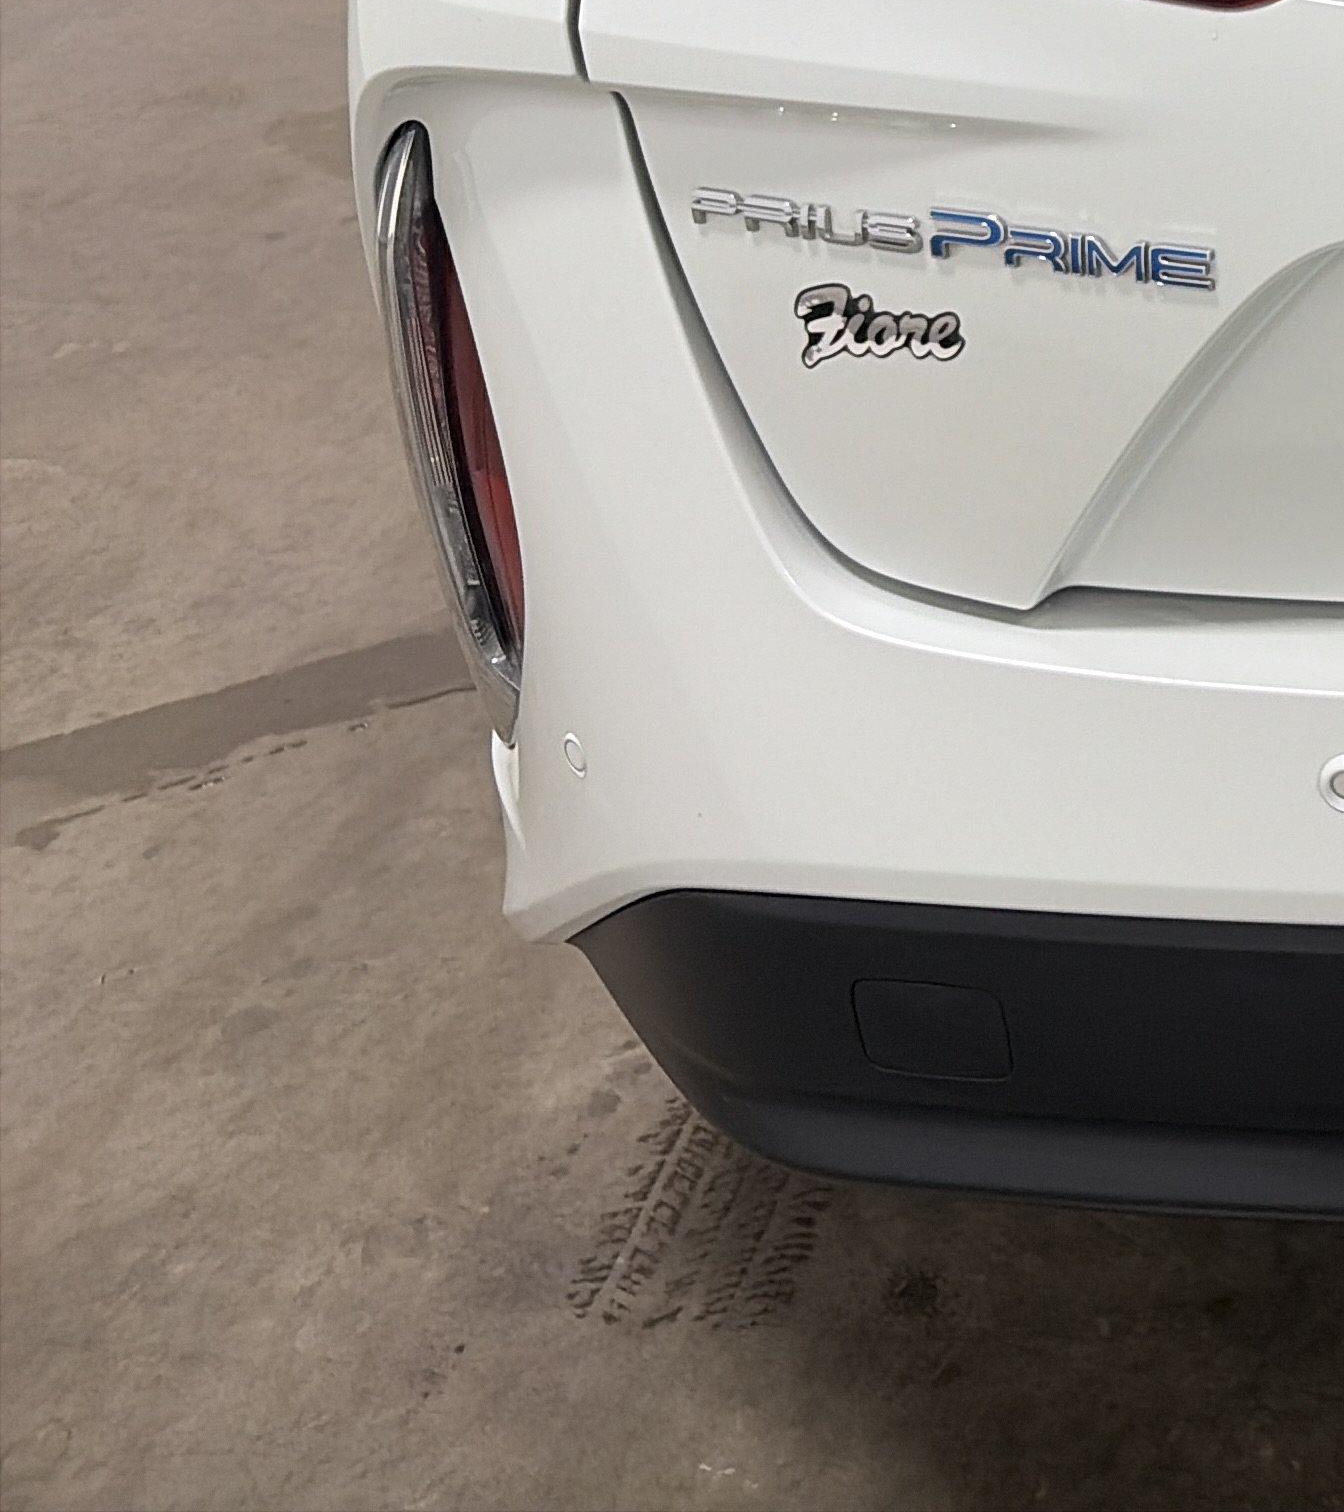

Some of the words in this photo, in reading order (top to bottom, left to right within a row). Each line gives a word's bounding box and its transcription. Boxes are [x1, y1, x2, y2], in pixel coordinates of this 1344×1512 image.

[691, 186, 924, 254] PRIUS
[929, 206, 1215, 292] PRIME
[794, 282, 966, 369] Fiore
